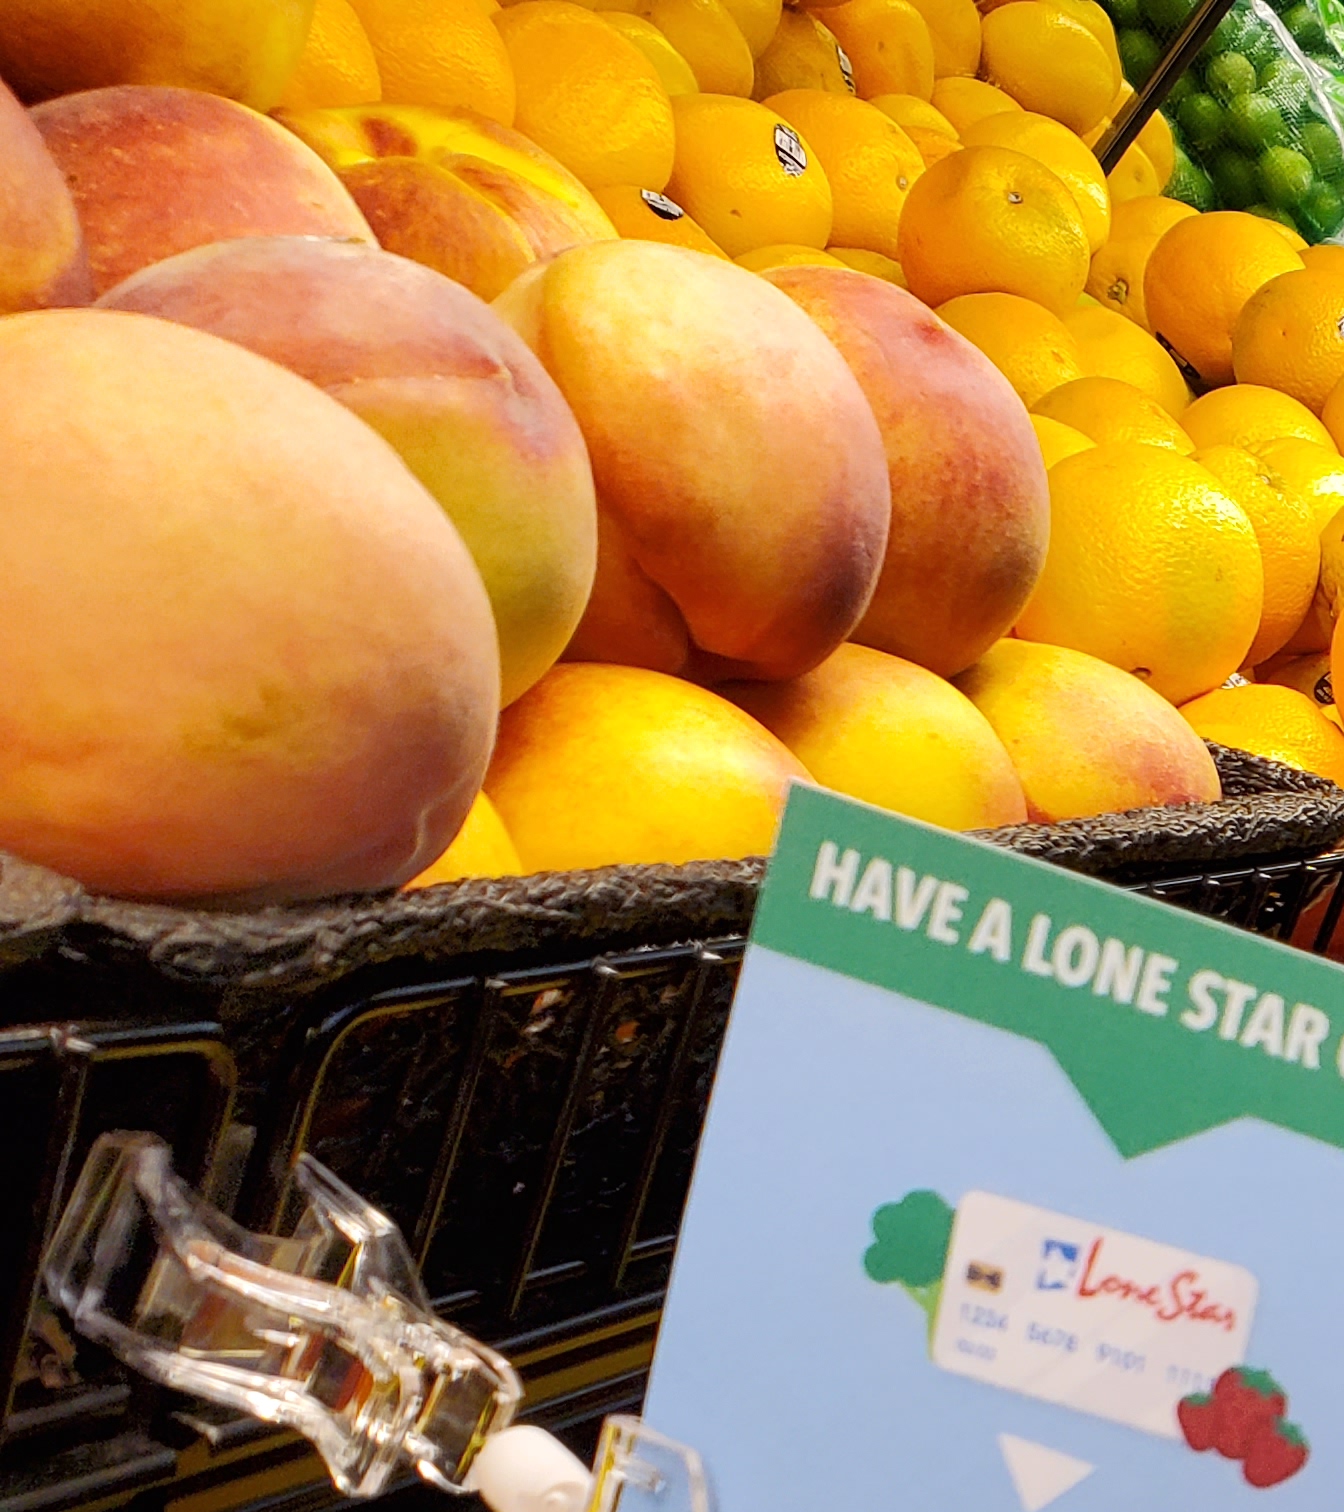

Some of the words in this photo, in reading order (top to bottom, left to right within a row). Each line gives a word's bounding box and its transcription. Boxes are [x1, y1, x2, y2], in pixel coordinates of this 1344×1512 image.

[808, 839, 972, 946] HAVE
[967, 896, 1014, 963] A
[1021, 913, 1179, 1018] LONE
[1186, 968, 1331, 1072] STAR
